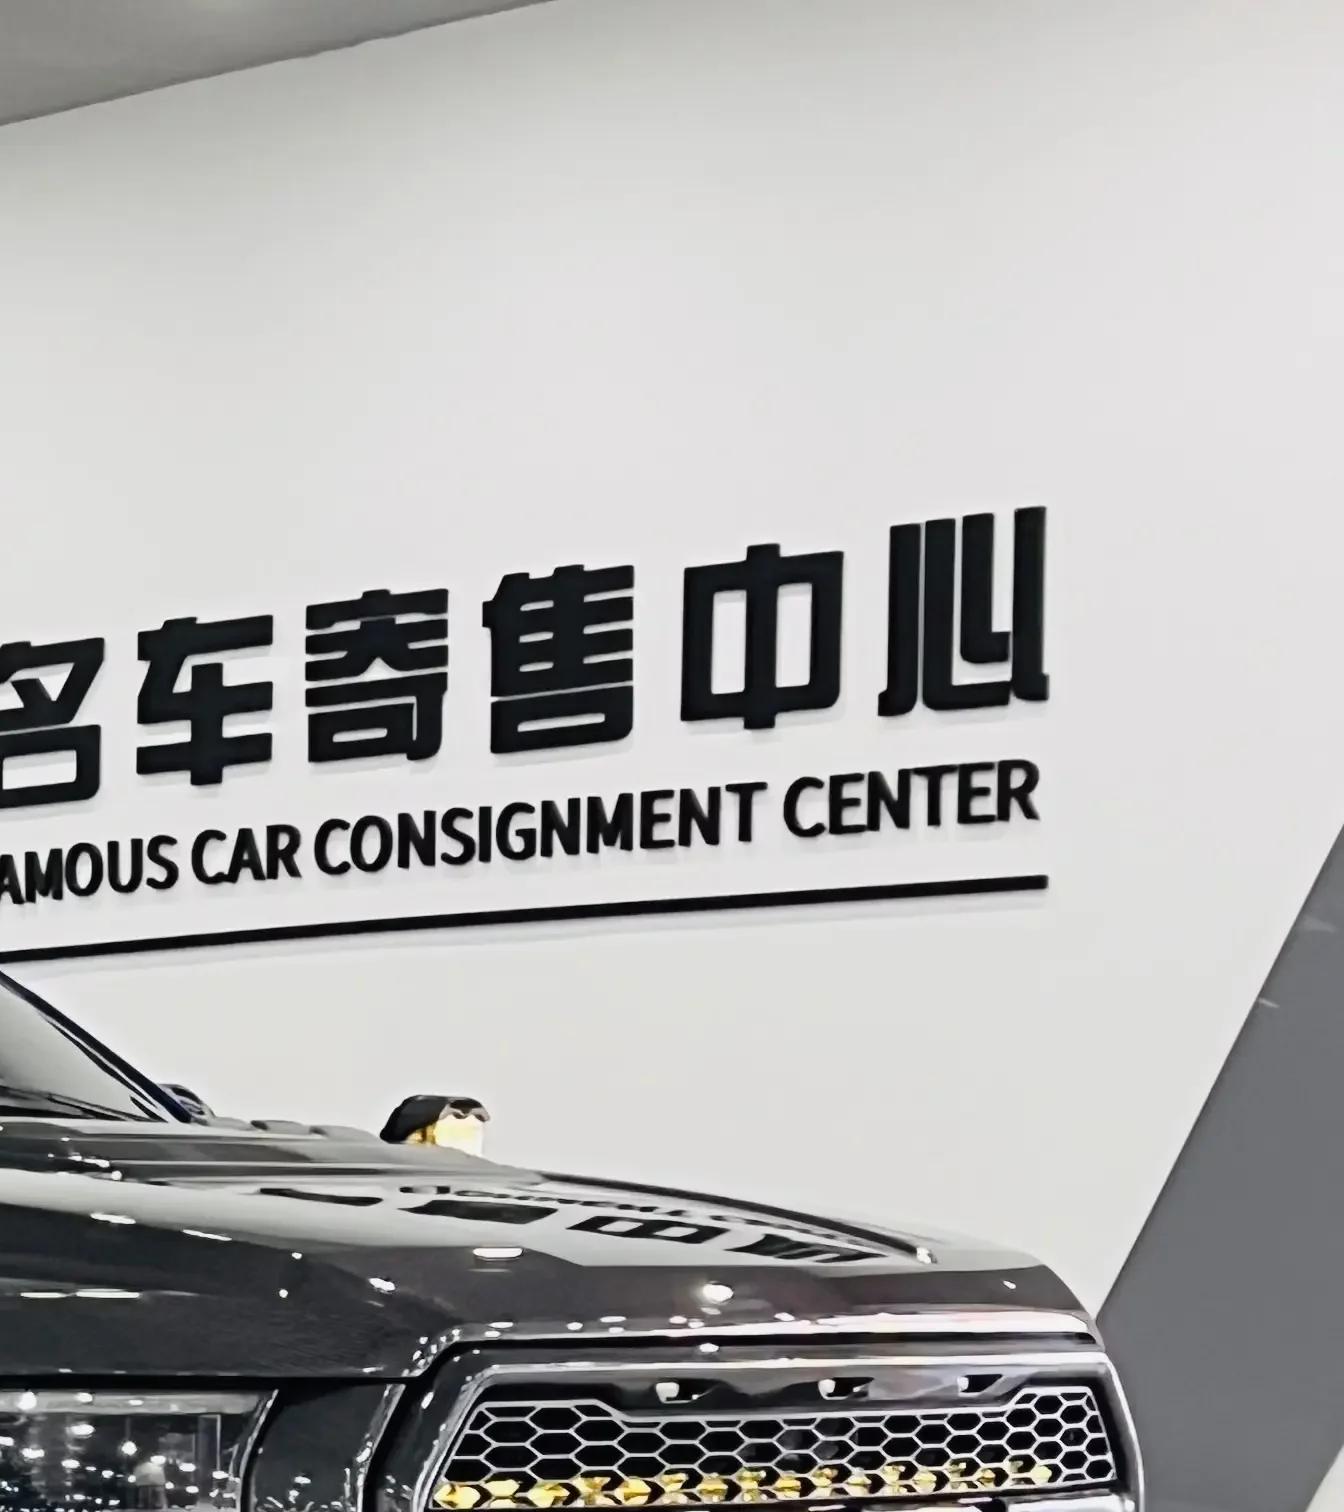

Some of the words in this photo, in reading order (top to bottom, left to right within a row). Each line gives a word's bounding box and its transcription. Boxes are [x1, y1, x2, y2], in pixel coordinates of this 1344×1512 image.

[191, 825, 302, 884] CAR
[313, 782, 767, 876] CONSIGNMENT
[783, 760, 1041, 839] CENTER
